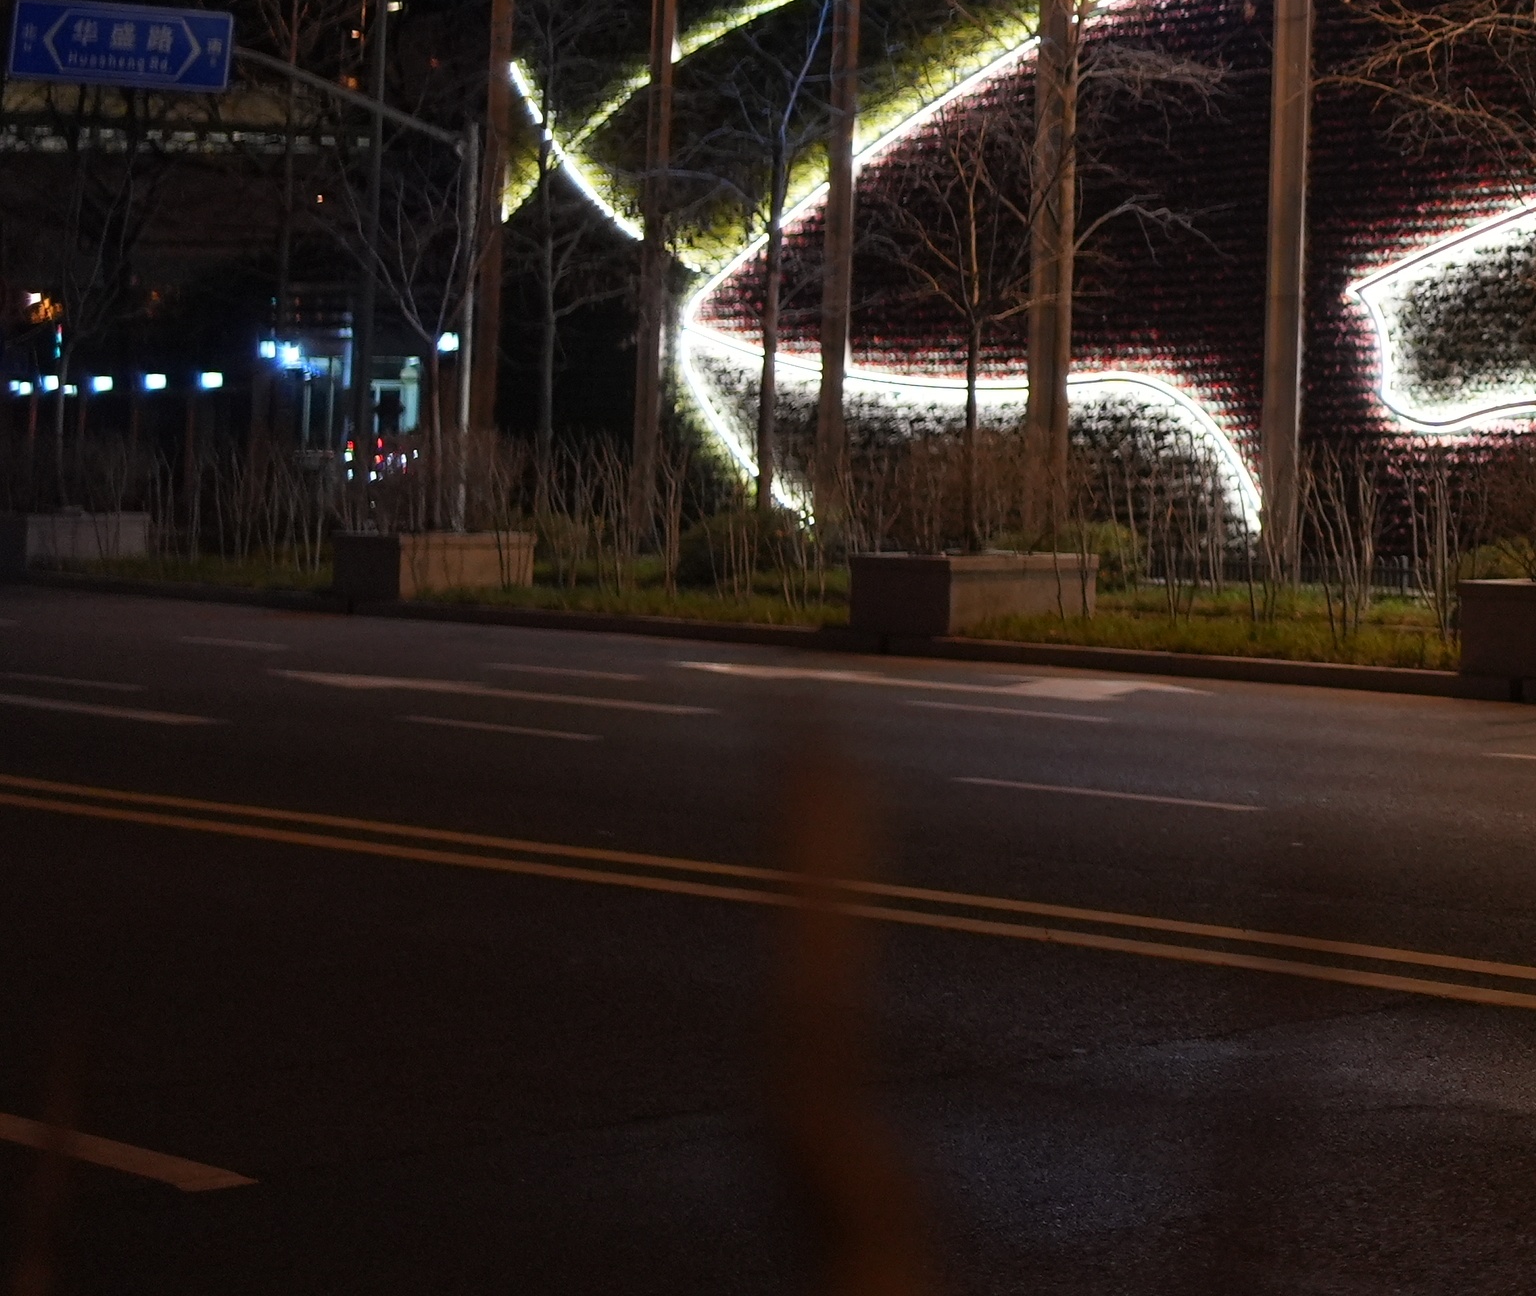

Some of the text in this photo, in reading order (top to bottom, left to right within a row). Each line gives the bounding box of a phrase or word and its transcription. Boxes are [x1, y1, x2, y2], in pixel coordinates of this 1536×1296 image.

[72, 18, 173, 54] 华盛路
[68, 50, 145, 74] Huasheng
